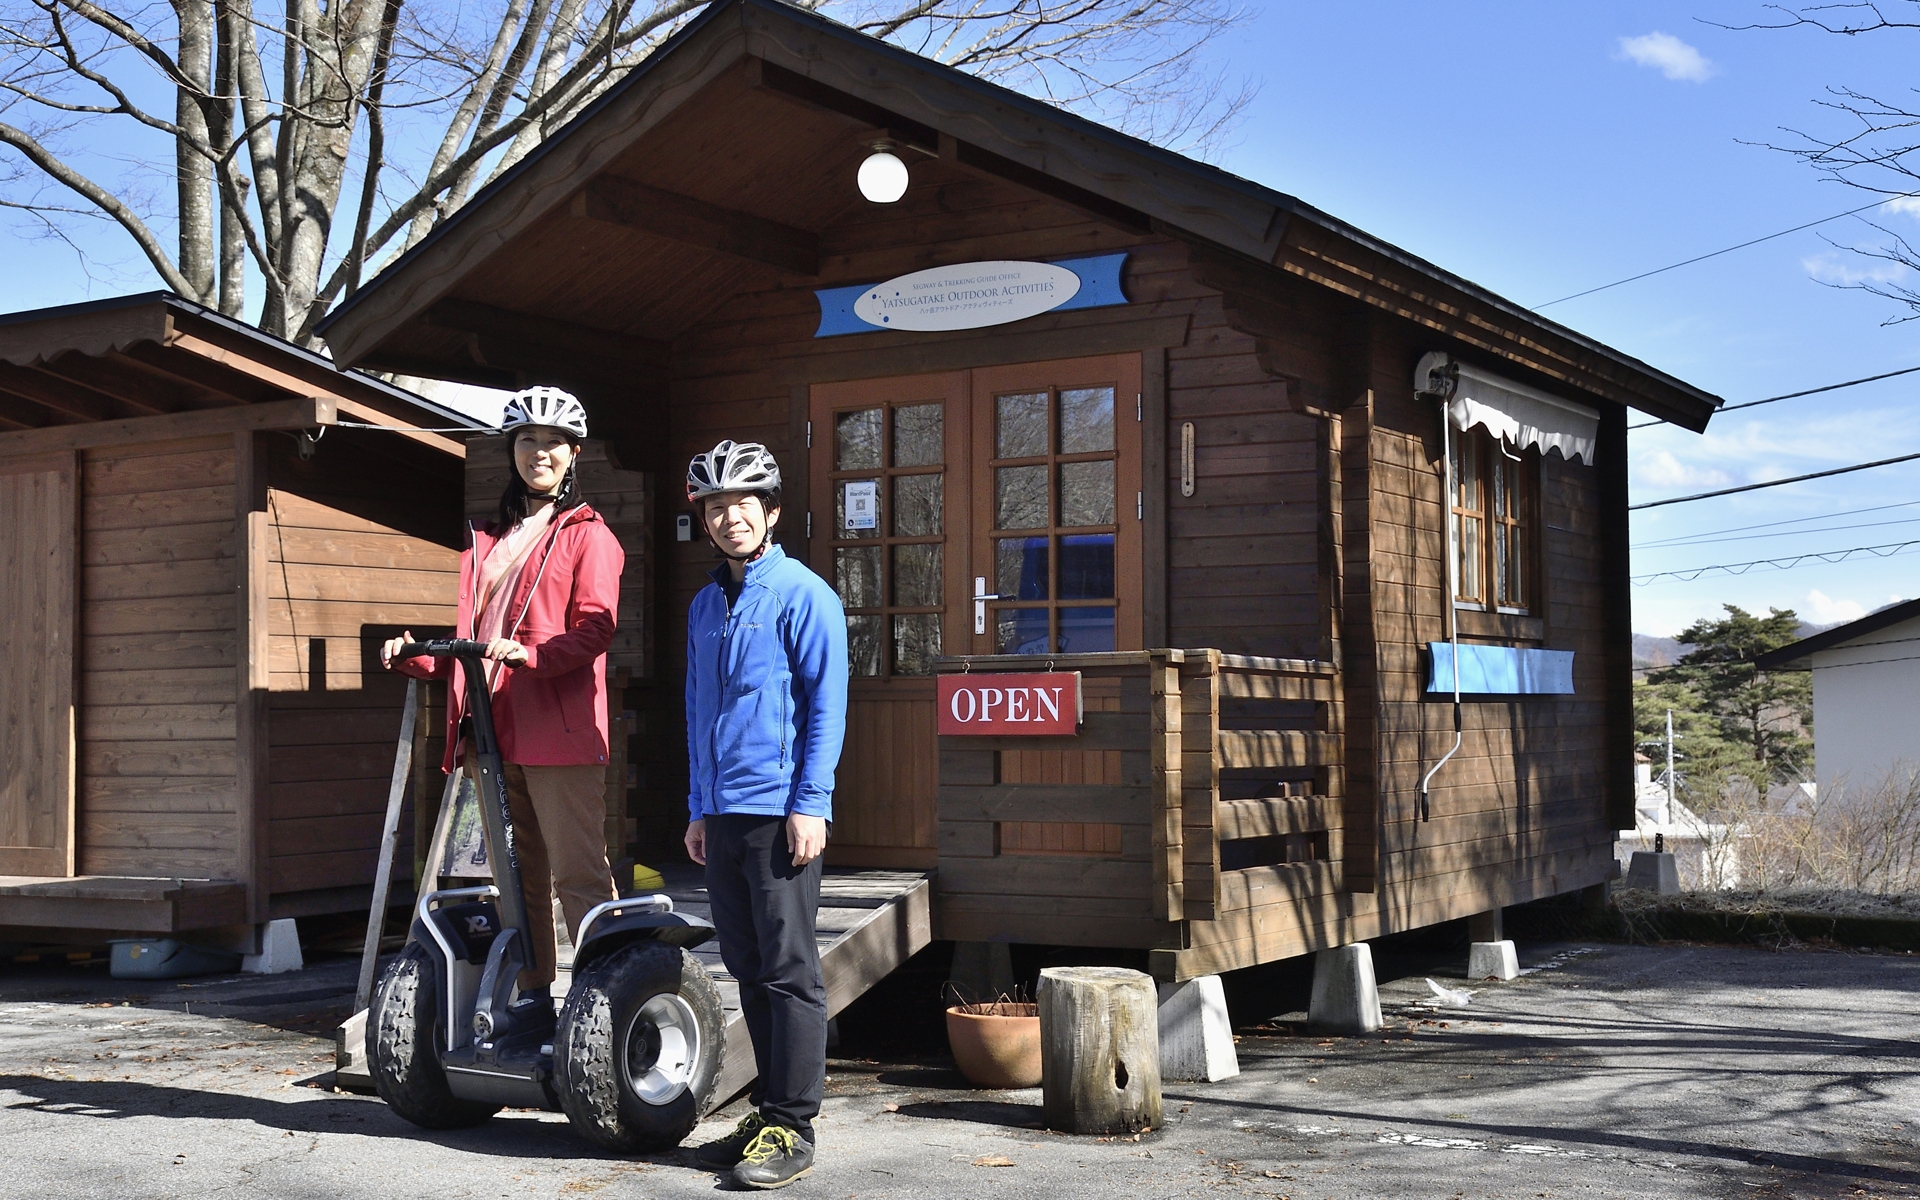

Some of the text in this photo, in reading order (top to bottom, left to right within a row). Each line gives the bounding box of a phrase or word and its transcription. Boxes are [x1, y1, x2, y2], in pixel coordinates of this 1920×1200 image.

[912, 282, 937, 290] SEGWAY
[944, 278, 976, 287] TREKKING
[976, 275, 997, 283] GUIDE
[998, 272, 1021, 280] OFFICE
[882, 282, 1054, 309] YATSUGATAKE OUTDOOR ACTIVITIES
[951, 687, 1063, 723] OPEN
[464, 915, 491, 933] X2
